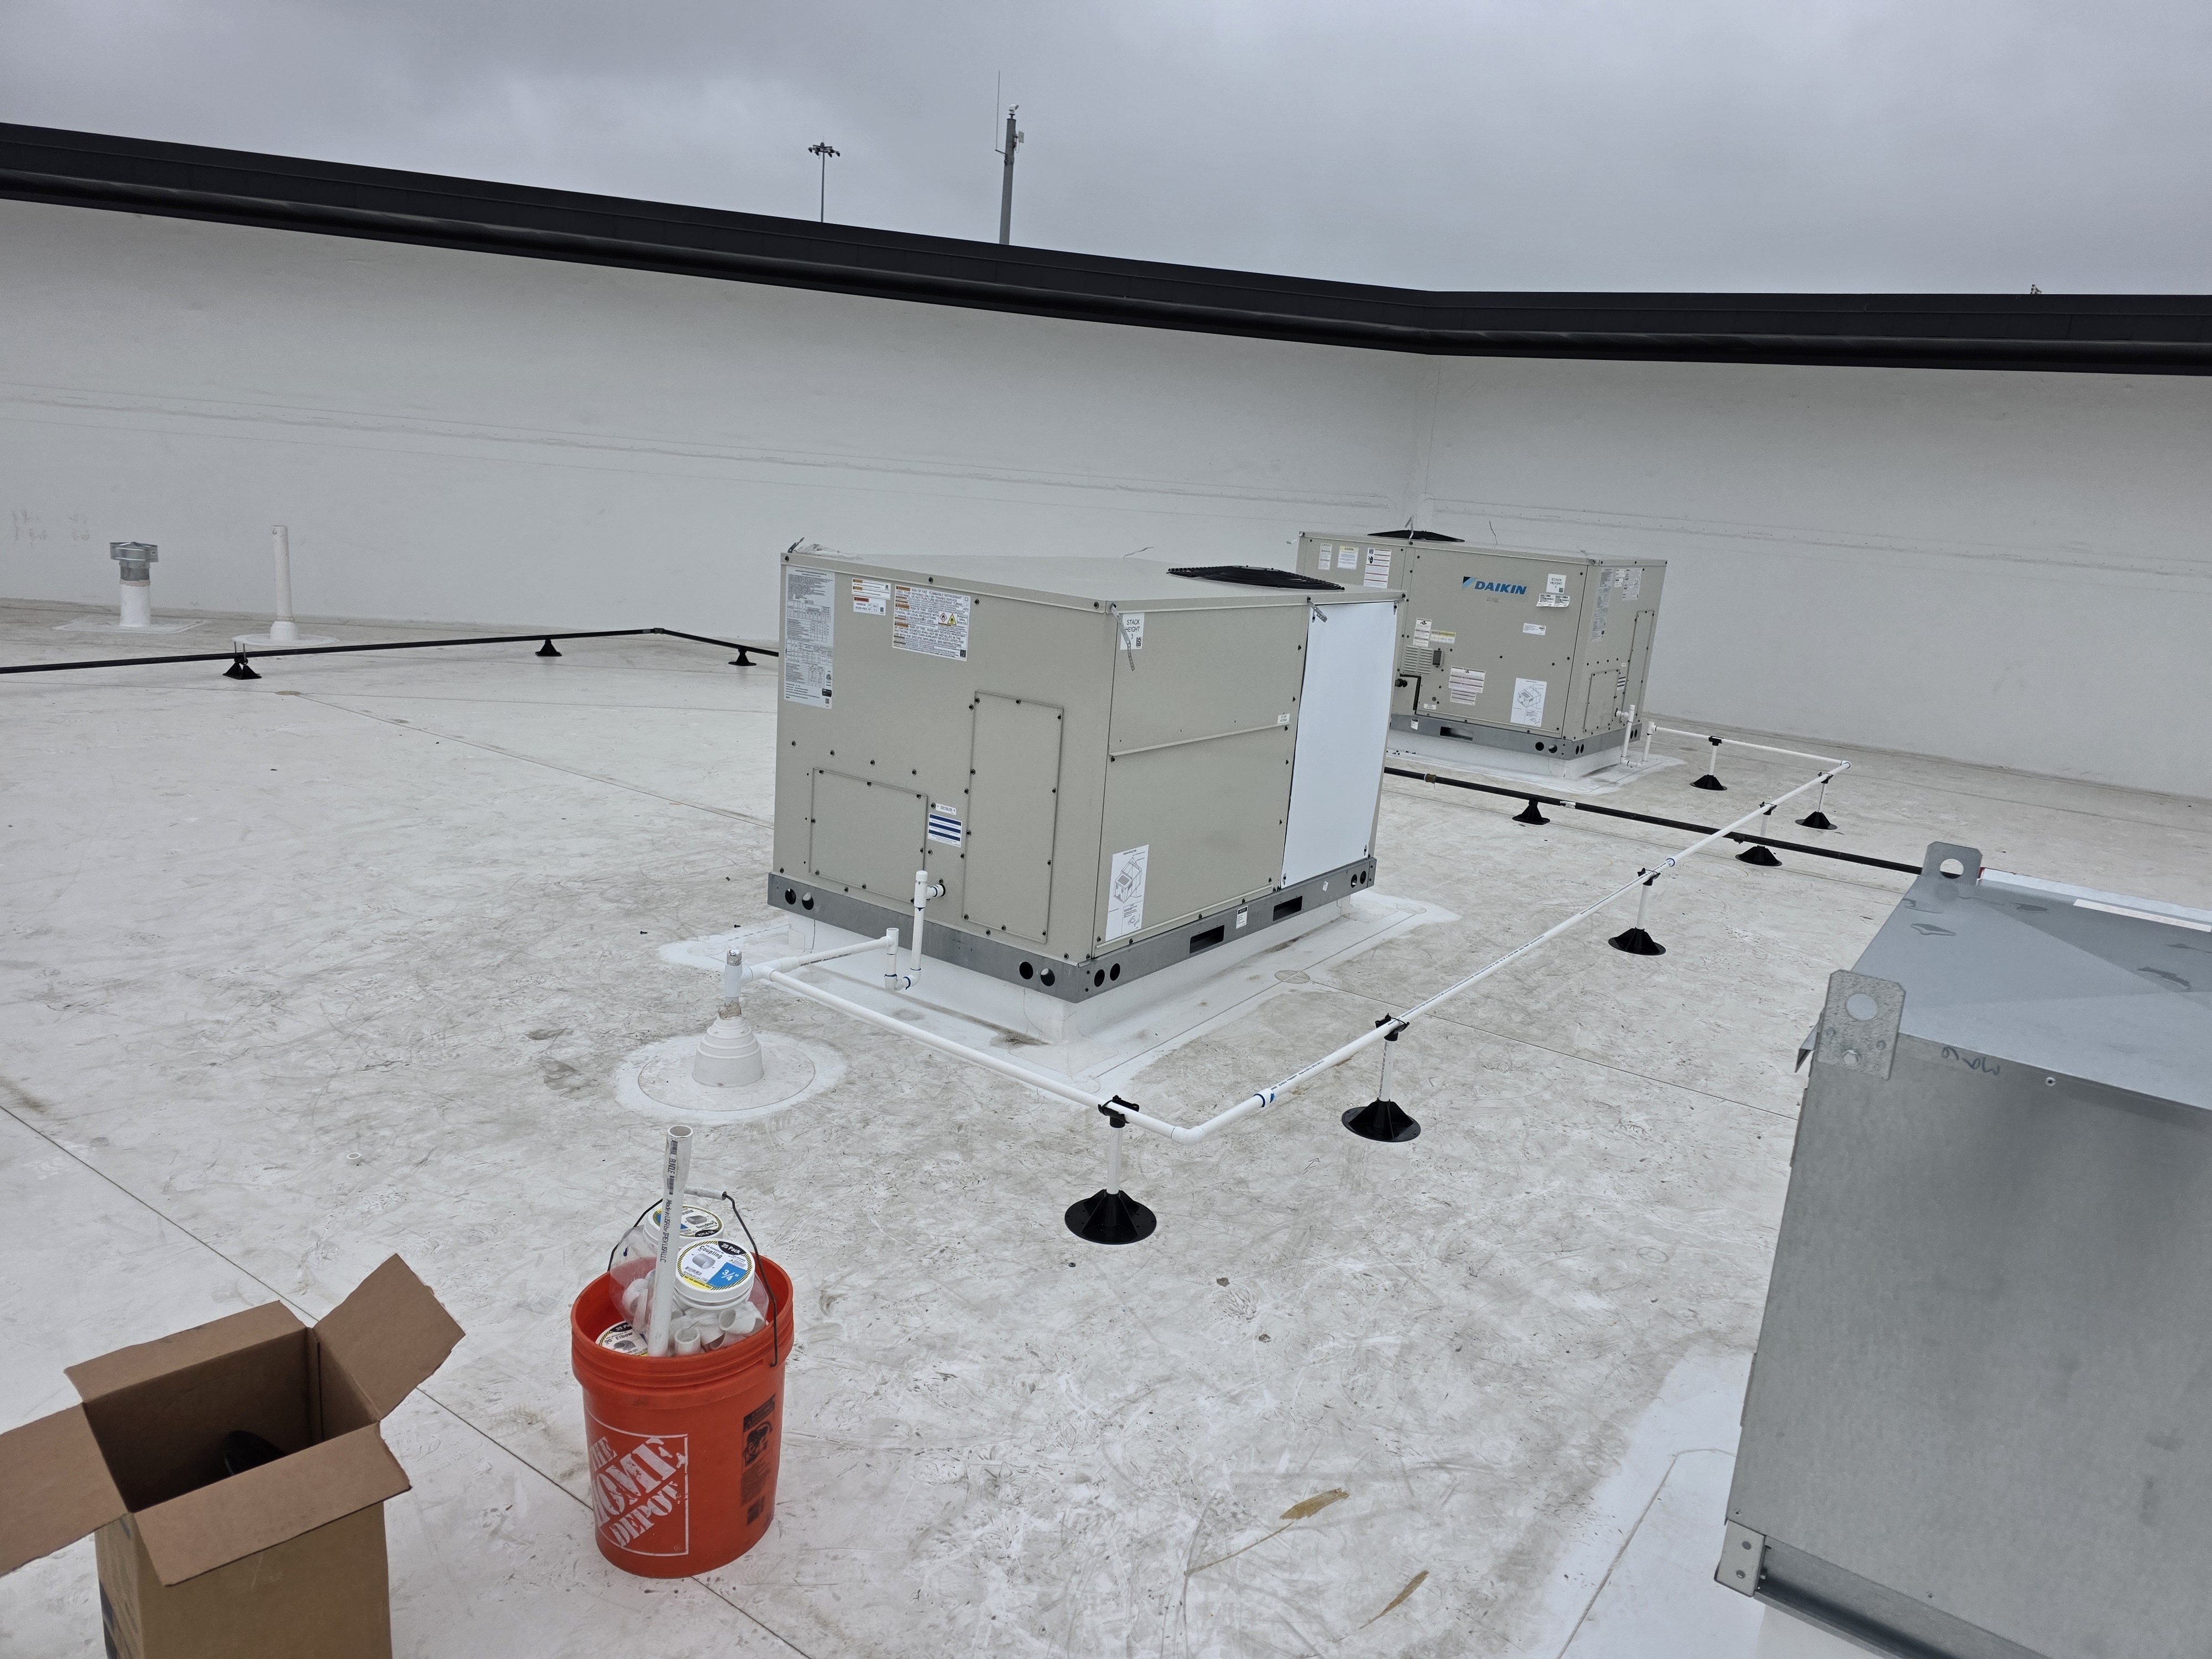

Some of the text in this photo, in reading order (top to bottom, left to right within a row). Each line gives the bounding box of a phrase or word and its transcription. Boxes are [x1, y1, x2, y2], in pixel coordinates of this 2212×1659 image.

[1474, 581, 1527, 594] DAIKIN
[668, 1158, 676, 1174] BUNDLE
[699, 1246, 722, 1259] Coupling
[721, 1269, 739, 1281] 3/4"
[615, 1332, 633, 1340] Elbow
[589, 1436, 617, 1472] THE
[592, 1437, 685, 1527] HOME
[609, 1481, 682, 1548] DEPOT
